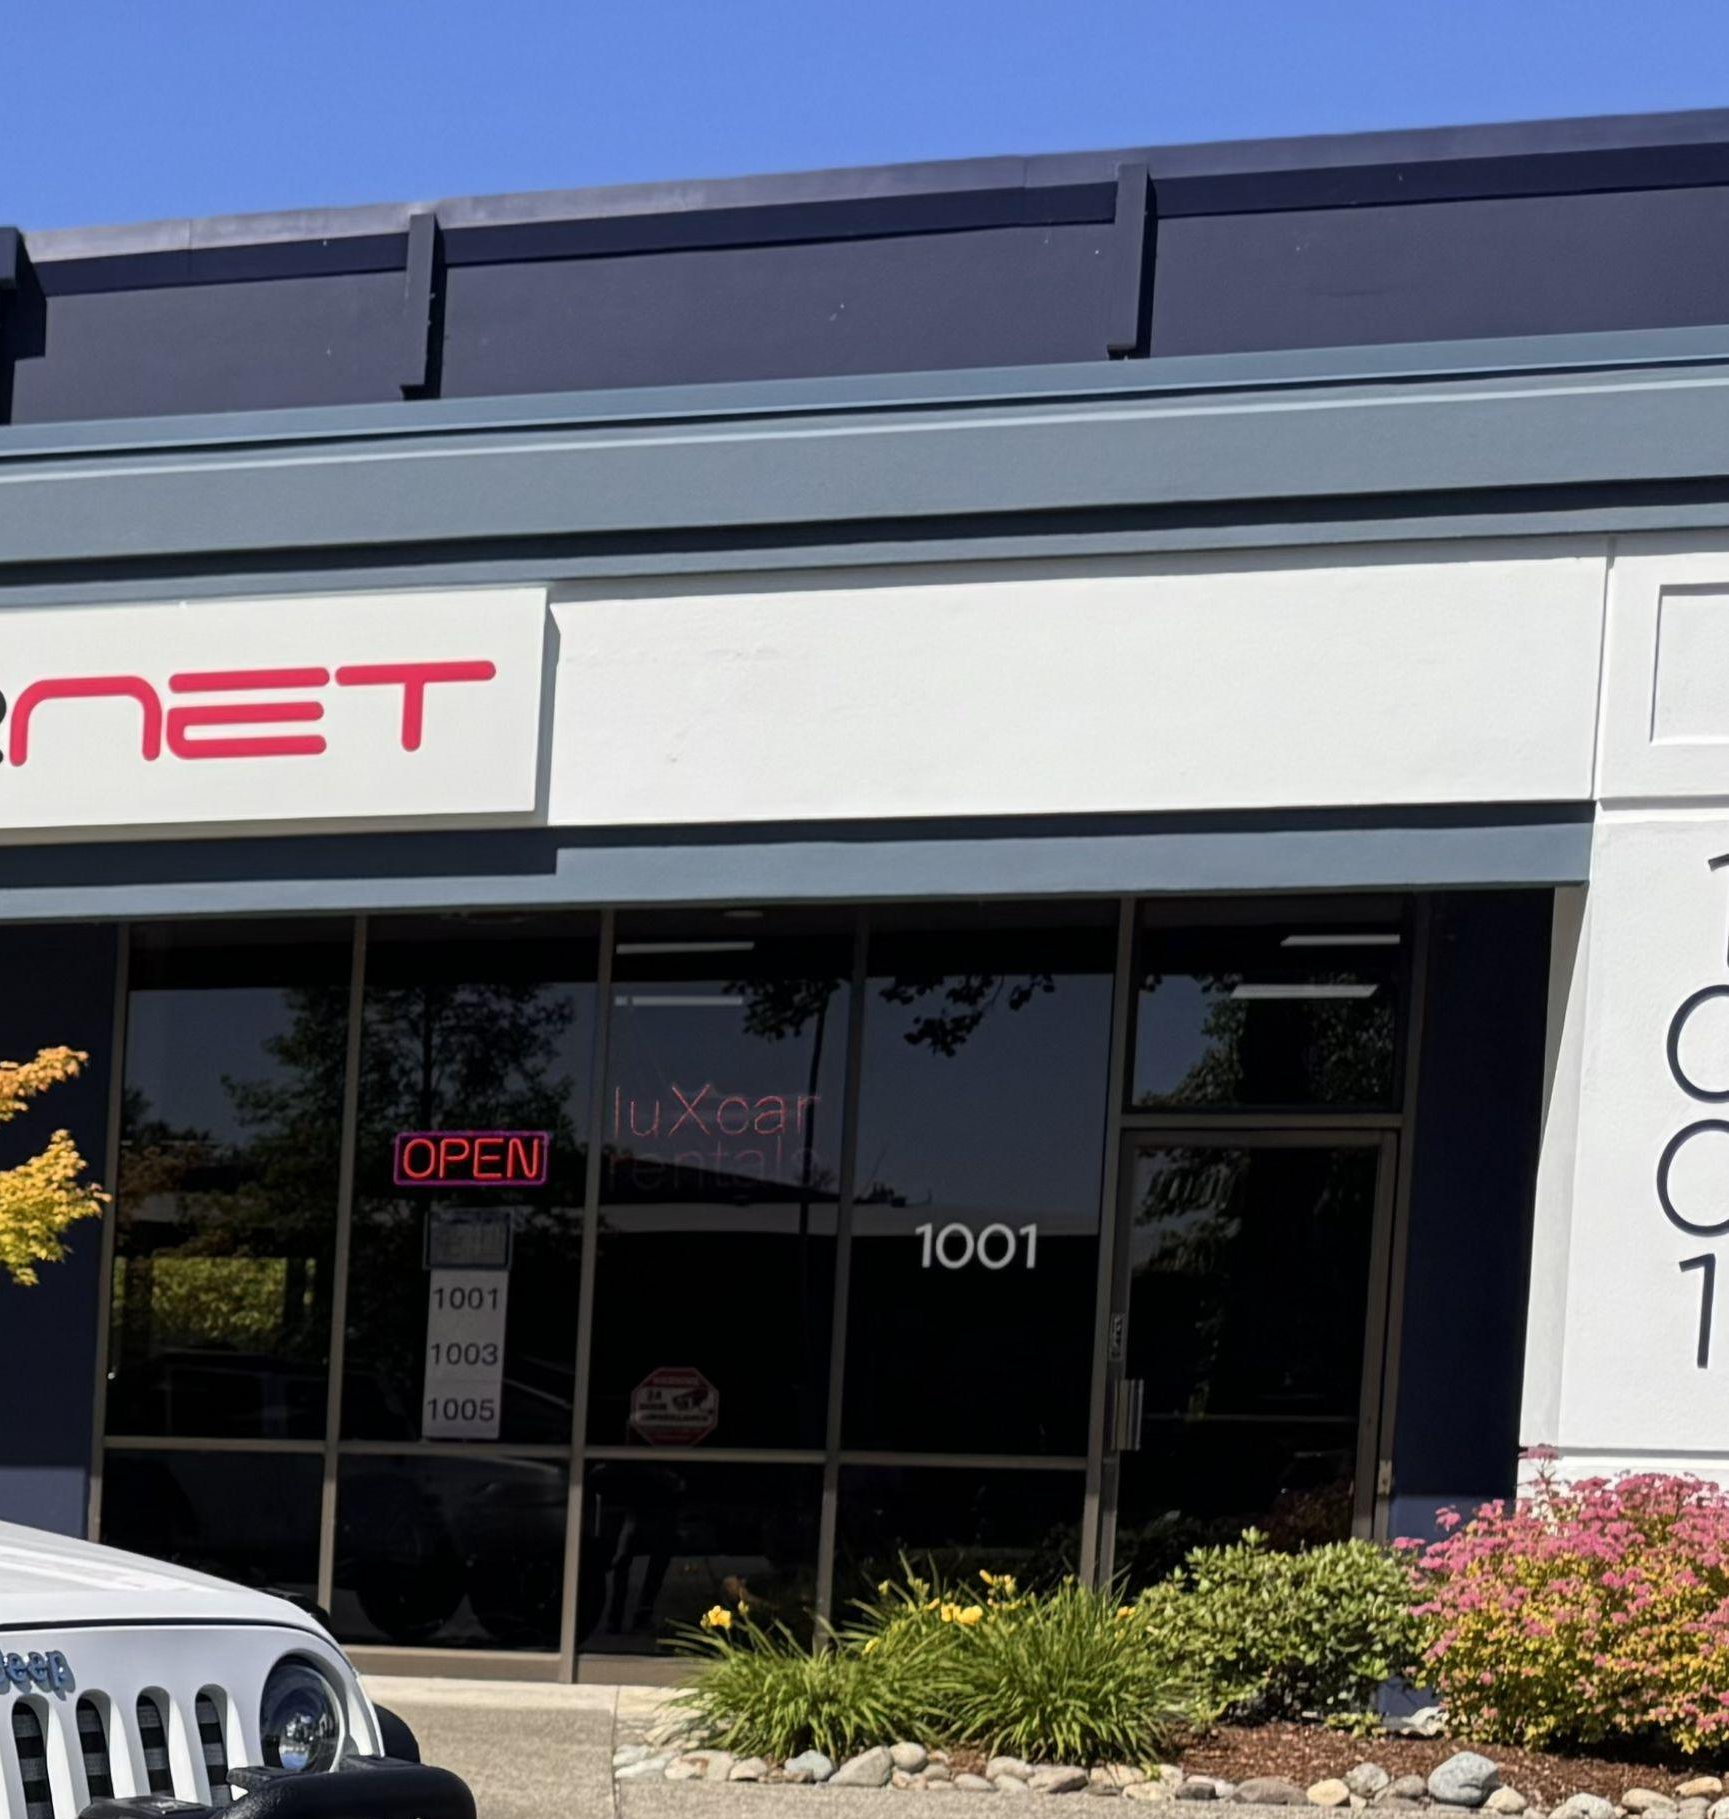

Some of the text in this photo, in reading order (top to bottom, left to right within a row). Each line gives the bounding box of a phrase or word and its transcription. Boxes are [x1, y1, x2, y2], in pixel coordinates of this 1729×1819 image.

[403, 1138, 540, 1179] OPEN
[915, 1223, 1038, 1270] 1001
[433, 1286, 499, 1310] 1001
[430, 1342, 499, 1366] 1003
[427, 1398, 495, 1422] 1005
